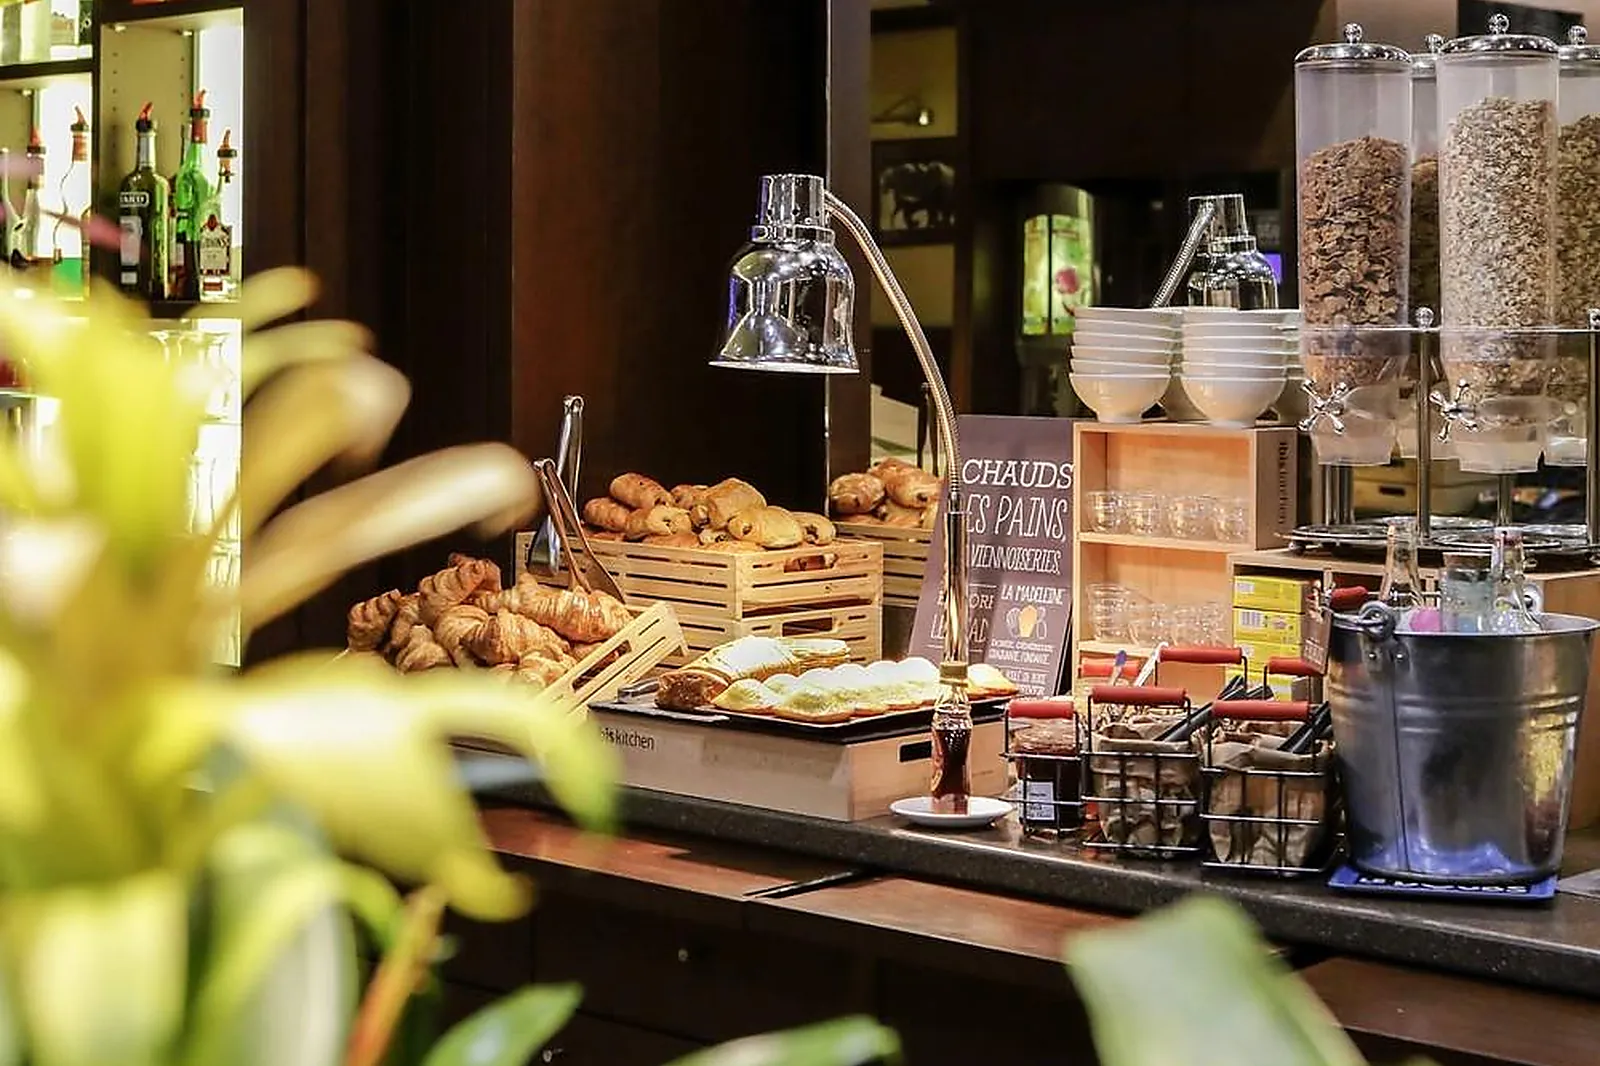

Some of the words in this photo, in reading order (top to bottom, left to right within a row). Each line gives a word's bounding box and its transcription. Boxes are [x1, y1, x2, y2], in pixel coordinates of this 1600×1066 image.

[962, 459, 1074, 490] CHAUDS
[966, 493, 991, 534] ES
[994, 495, 1068, 542] PAINS,
[1001, 584, 1014, 601] LA
